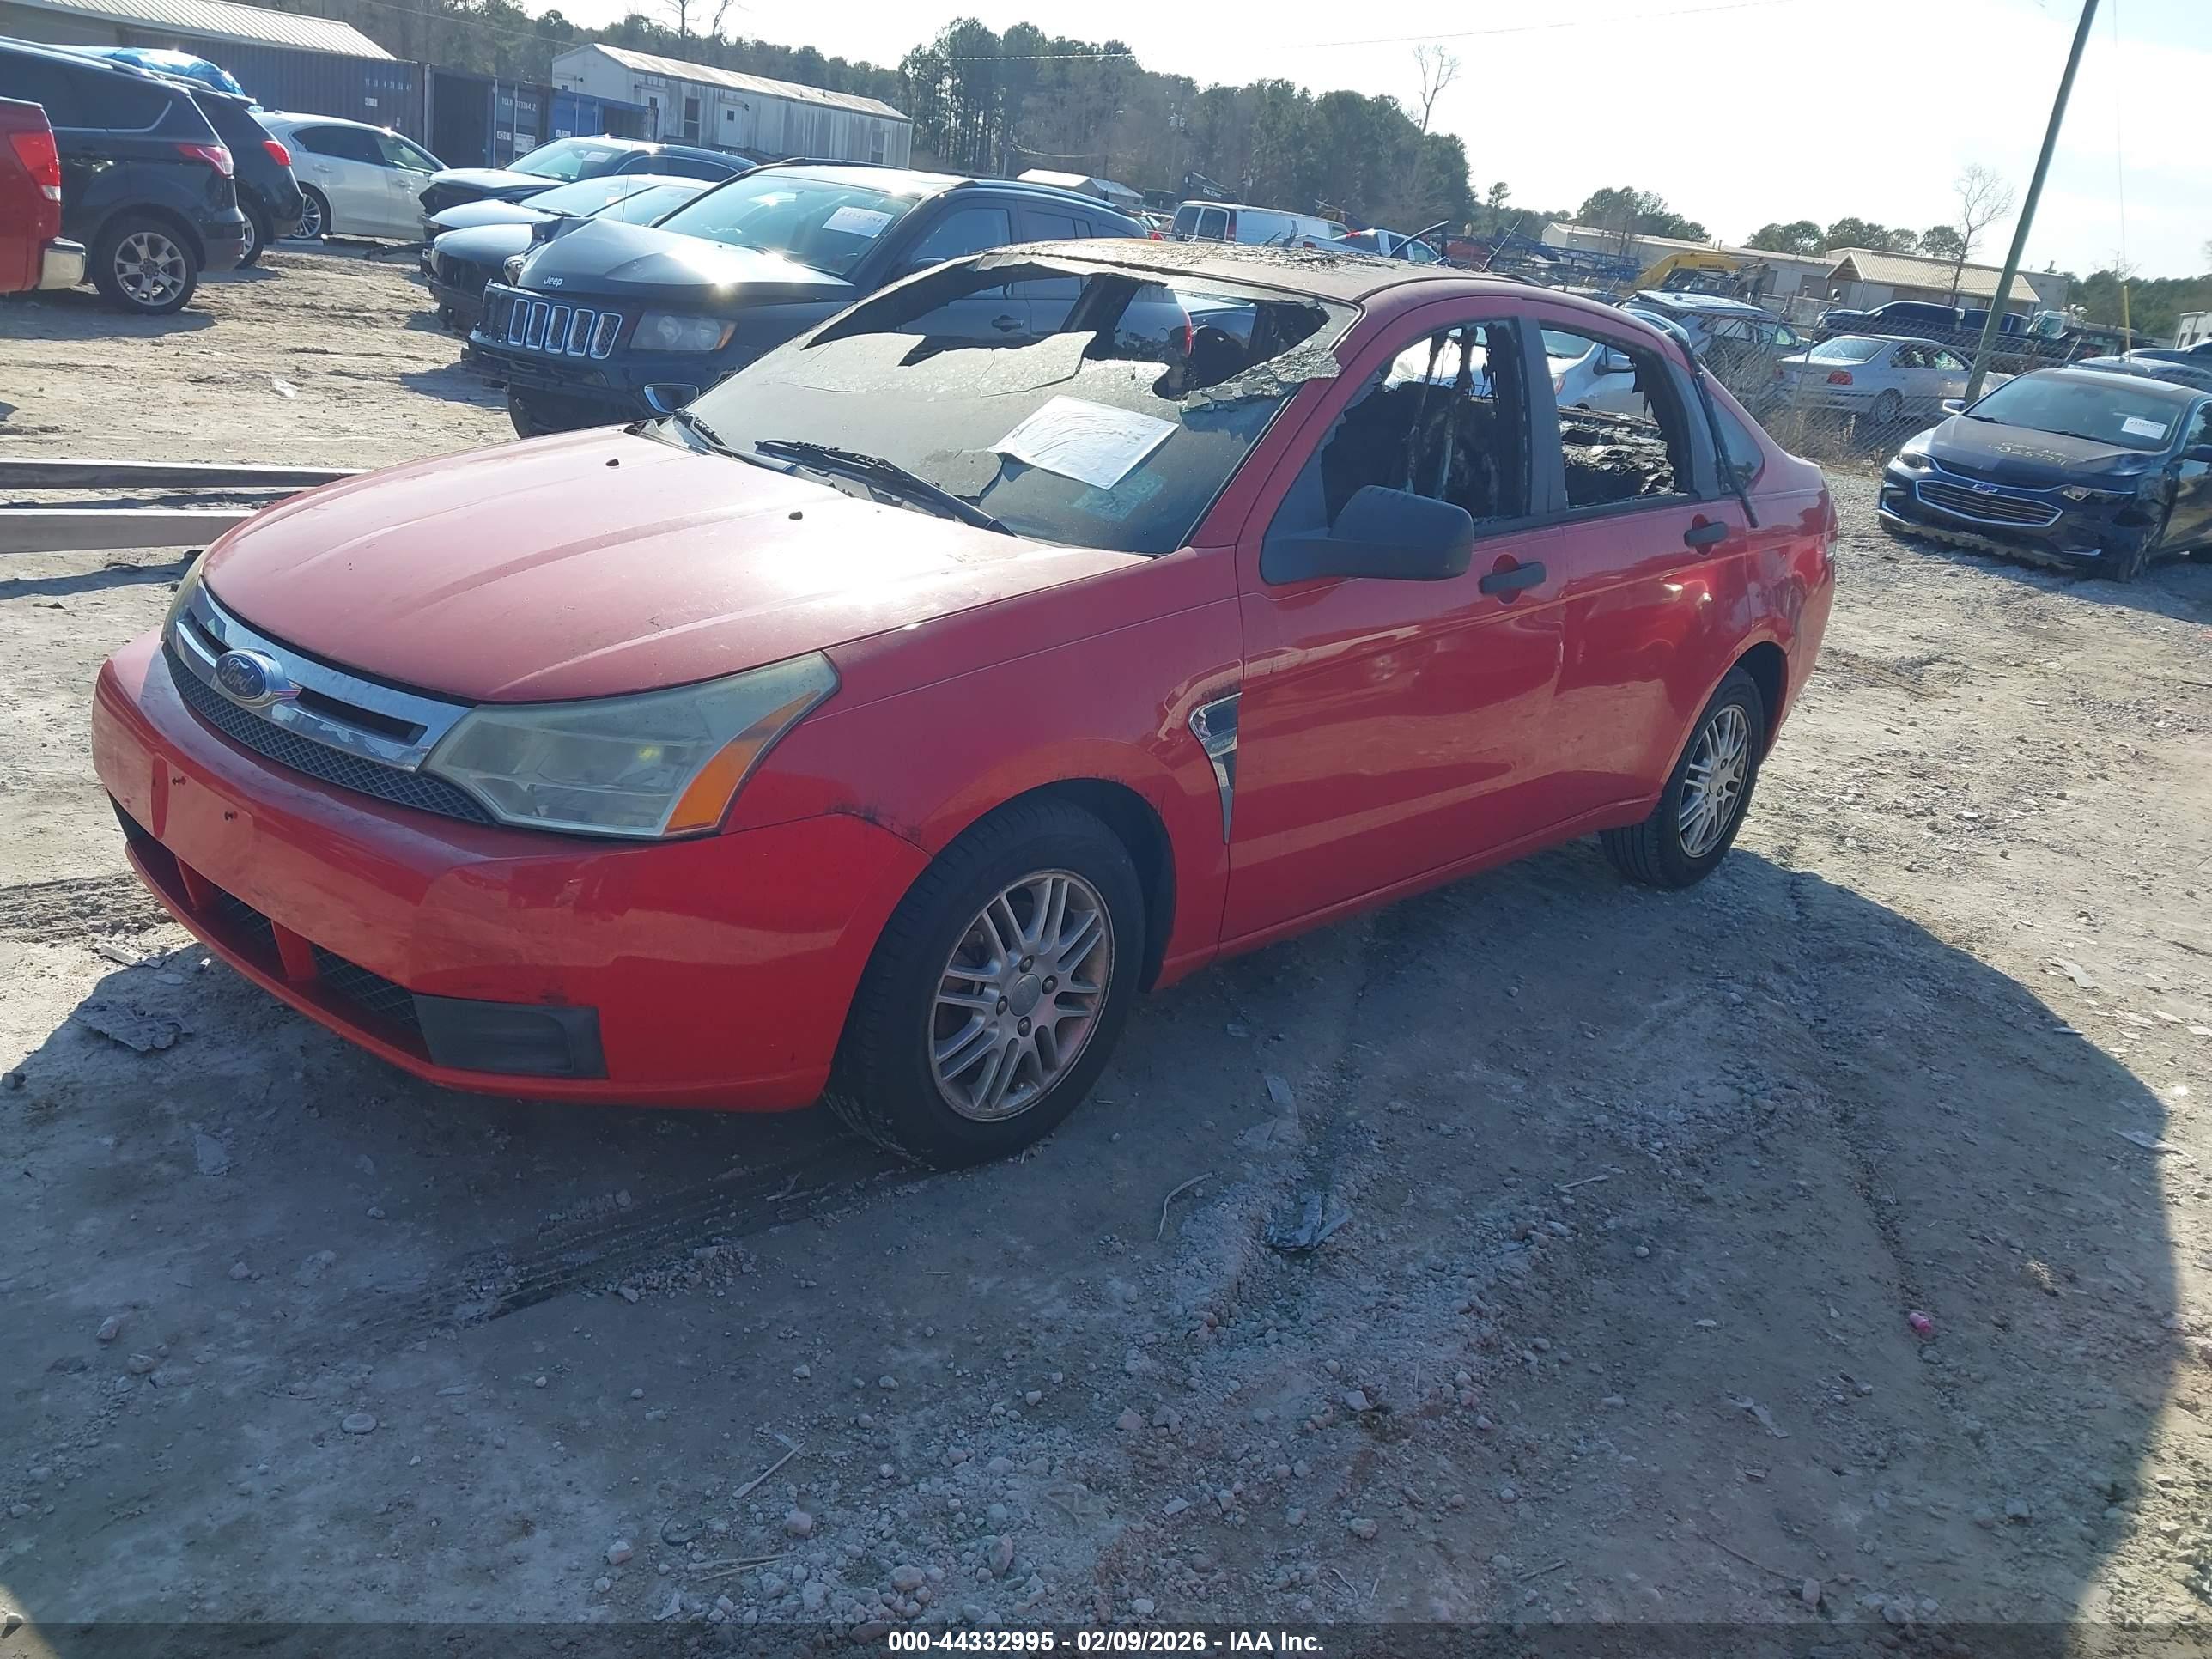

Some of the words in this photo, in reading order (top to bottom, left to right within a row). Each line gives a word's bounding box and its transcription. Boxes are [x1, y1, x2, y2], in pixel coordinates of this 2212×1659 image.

[1202, 187, 1223, 198] DEERE
[543, 275, 563, 288] Jeep
[220, 657, 255, 693] Ford
